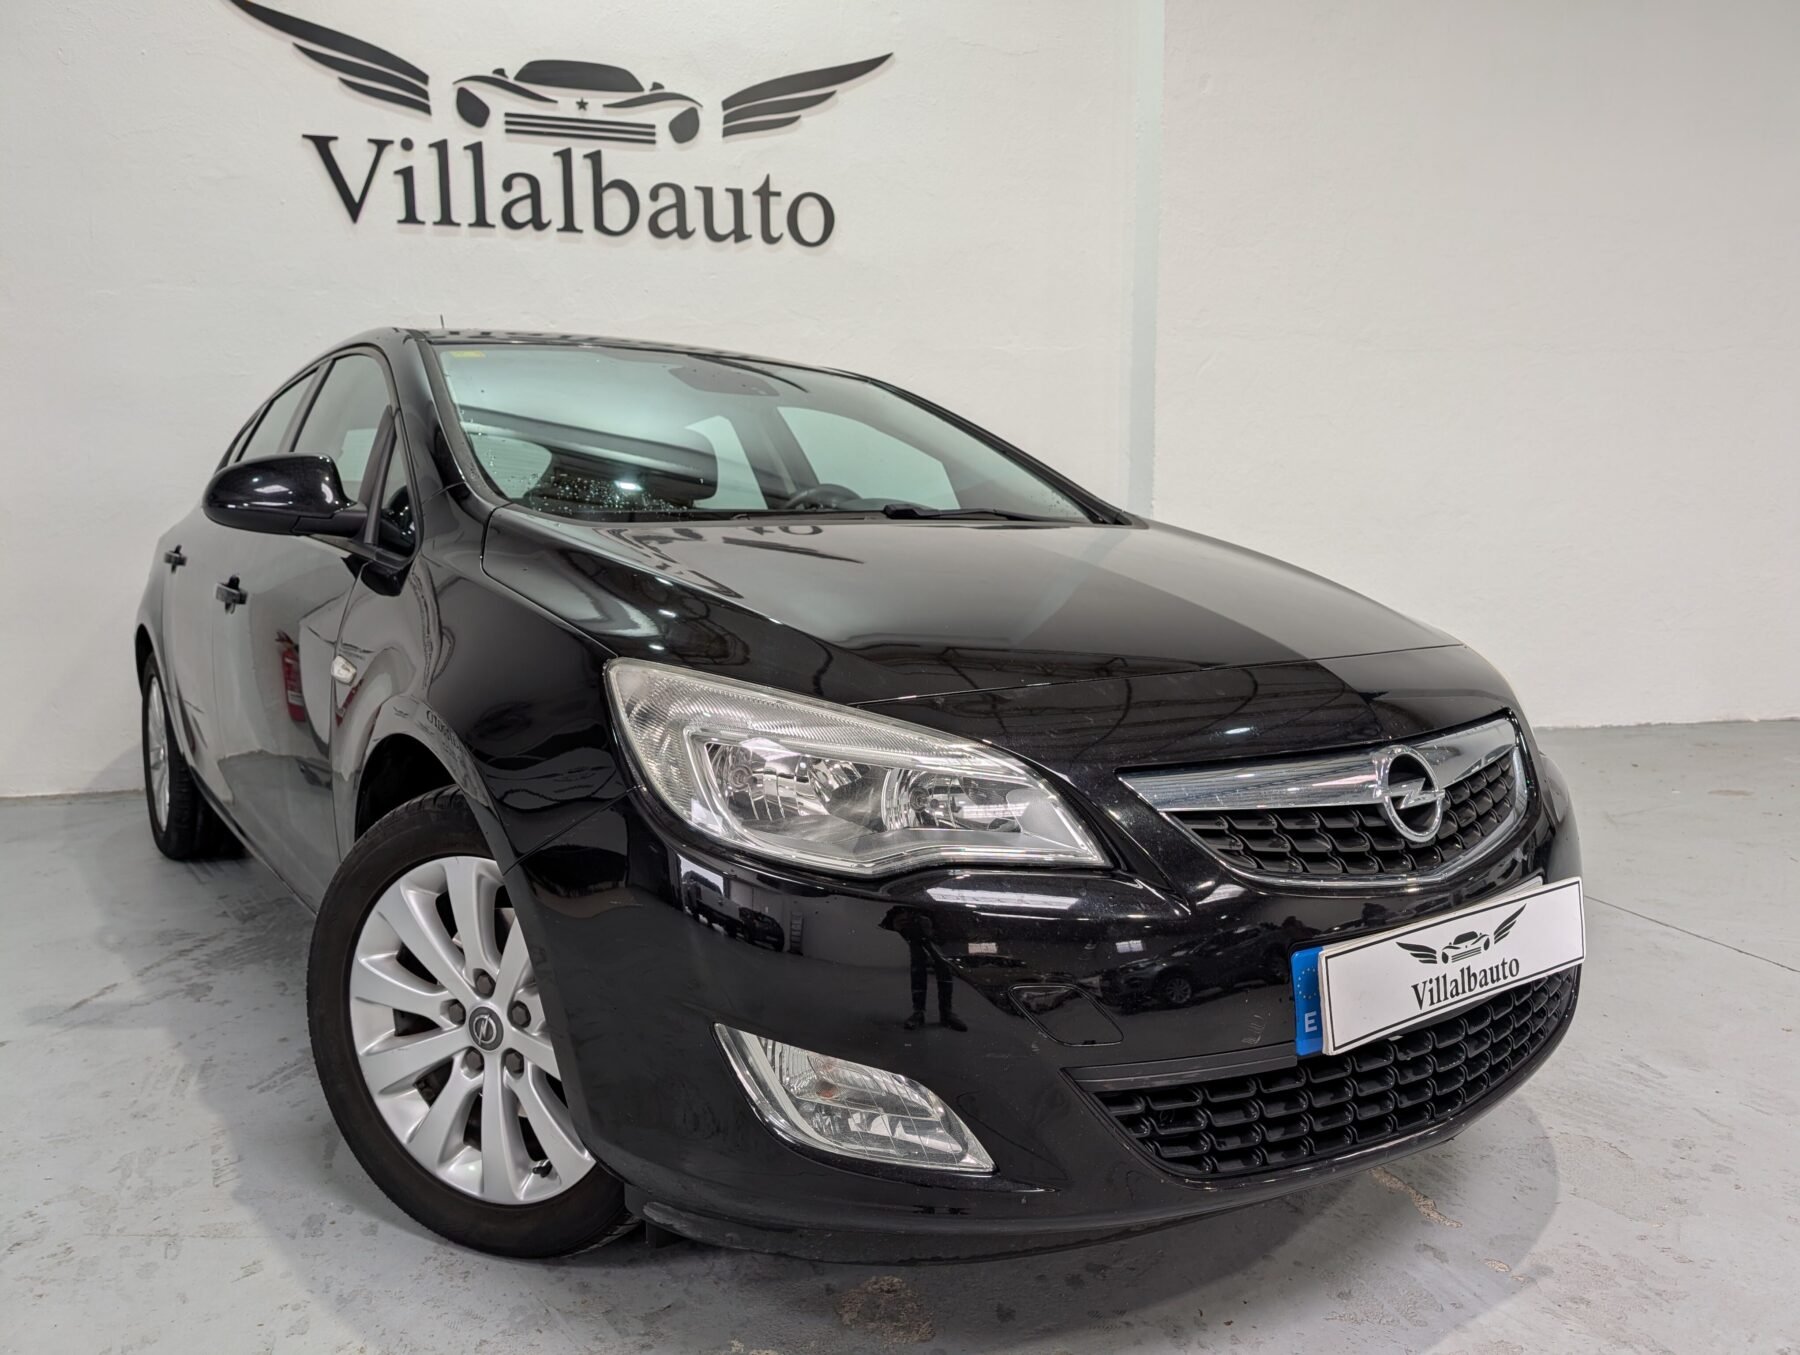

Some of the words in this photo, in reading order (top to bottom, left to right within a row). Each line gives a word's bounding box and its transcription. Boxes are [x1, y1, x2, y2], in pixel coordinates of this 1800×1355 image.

[302, 134, 835, 247] Villalbauto
[1411, 957, 1520, 1011] Villalbauto
[1304, 1011, 1318, 1033] E
